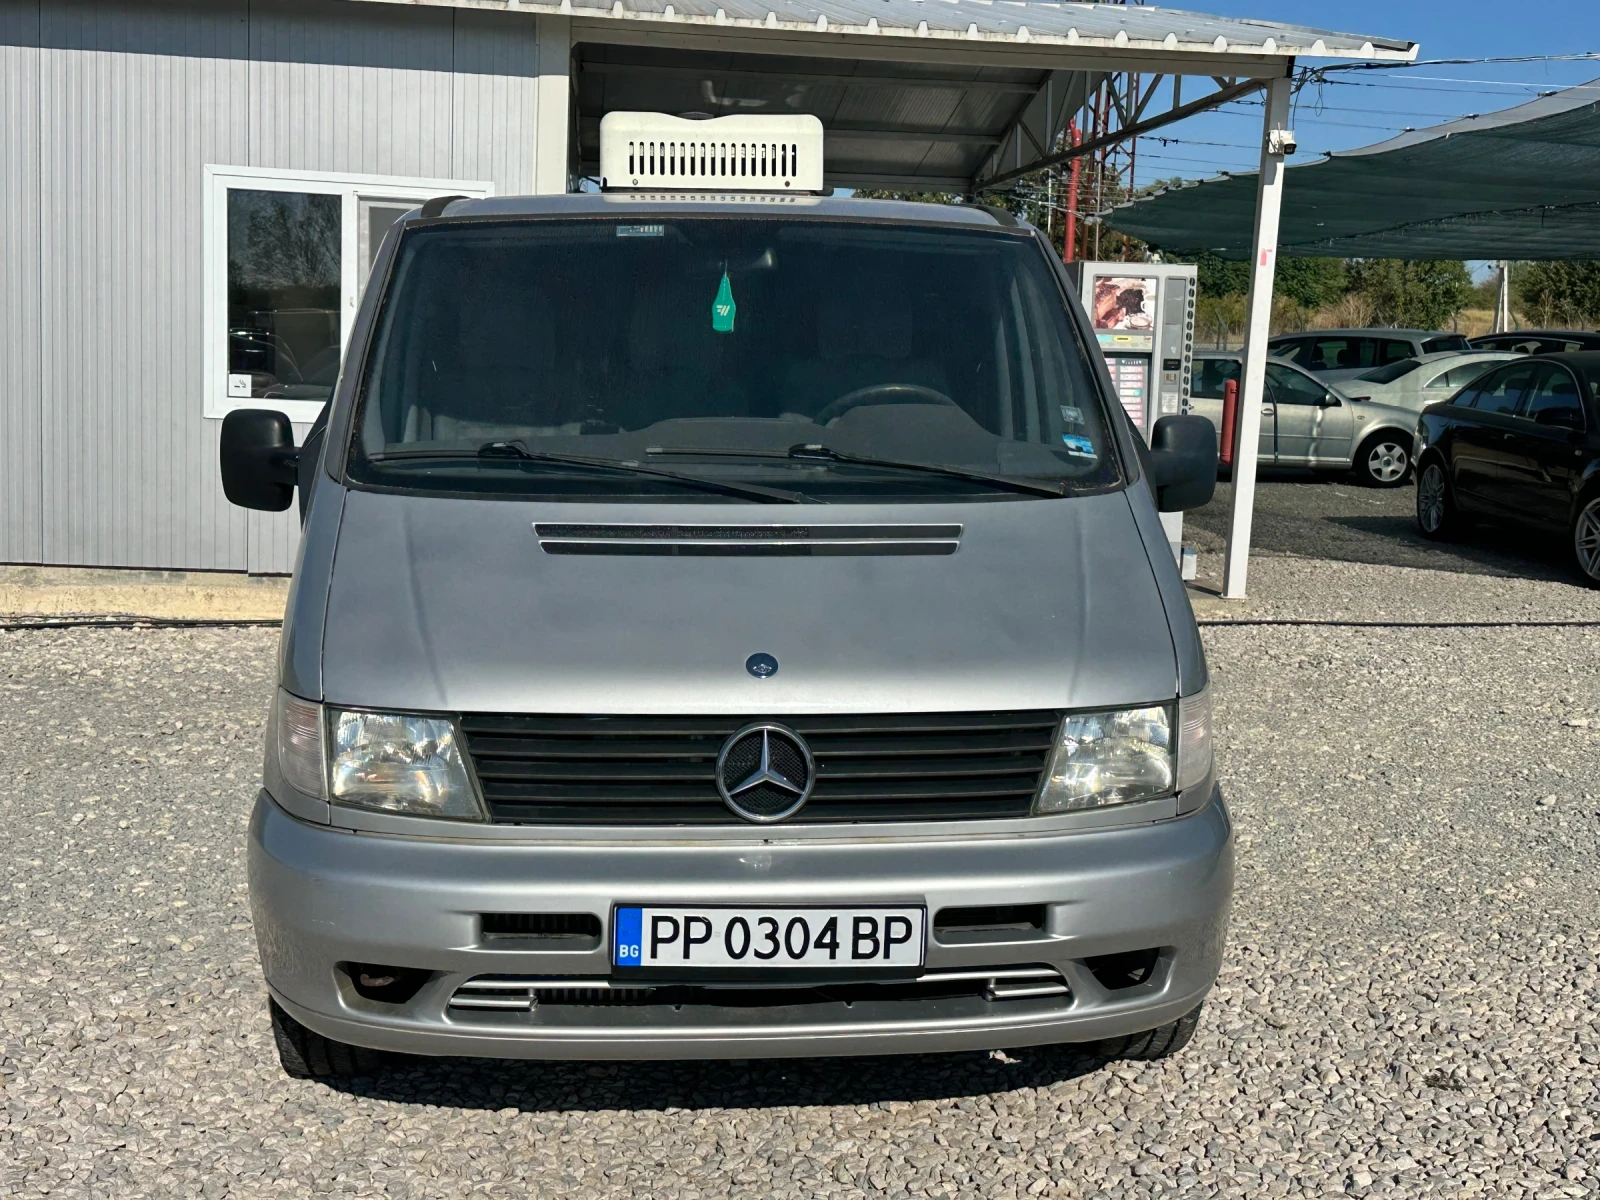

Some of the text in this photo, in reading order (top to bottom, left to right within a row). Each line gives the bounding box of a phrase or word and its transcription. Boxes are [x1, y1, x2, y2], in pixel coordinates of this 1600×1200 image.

[619, 945, 639, 957] BG
[649, 915, 912, 960] PP 0304 BP
